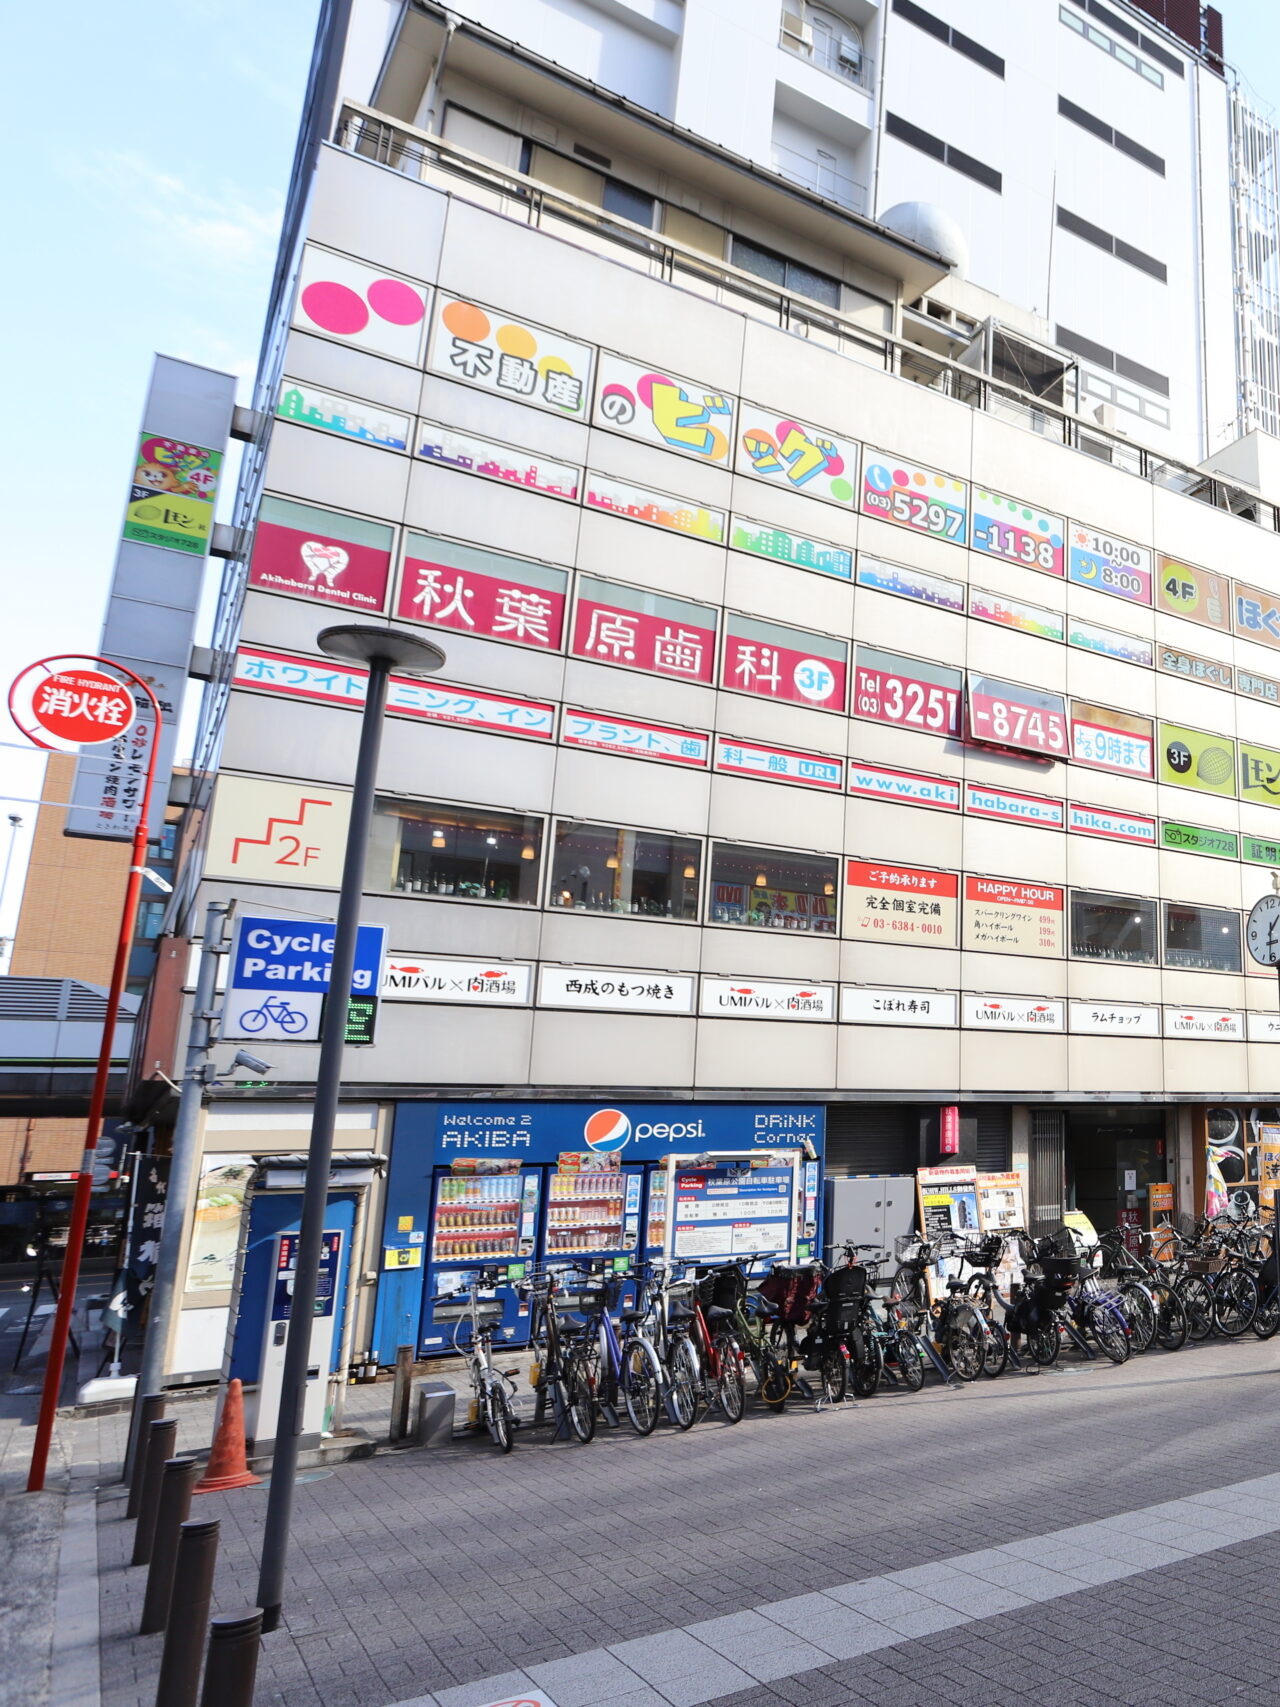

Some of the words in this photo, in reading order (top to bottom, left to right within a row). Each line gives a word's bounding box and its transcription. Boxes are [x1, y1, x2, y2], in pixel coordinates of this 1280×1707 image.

[189, 472, 214, 485] 4F
[133, 488, 150, 499] 3F
[866, 489, 892, 511] (03)
[1092, 536, 1141, 568] 10:00
[260, 572, 315, 592] Akihabara
[317, 584, 351, 600] Dental
[352, 591, 377, 605] Clinic
[1102, 567, 1142, 594] 8:00
[1164, 575, 1196, 601] 4F
[53, 674, 76, 687] FIRE
[77, 678, 122, 693] HYDRANT
[798, 666, 831, 692] 3F
[860, 672, 880, 694] Tel
[38, 685, 128, 727] 消火栓
[858, 697, 881, 716] (03)
[1076, 727, 1149, 769] よる9時まで
[1169, 748, 1190, 766] 3F
[798, 762, 836, 781] URL
[275, 834, 321, 867] 2F
[1182, 832, 1235, 854] スタジオ728
[867, 869, 938, 889] ご予約承ります
[977, 881, 1018, 897] HAPPY
[1021, 887, 1055, 902] HOUR
[864, 896, 942, 917] 完全個室完備
[1265, 899, 1276, 910] 12
[974, 909, 1033, 922] スパークリングワイン
[872, 918, 943, 936] 03-6384-0010
[1251, 931, 1258, 941] 9
[246, 928, 335, 956] Cycle
[1270, 952, 1277, 963] 6
[242, 957, 373, 990] Parkig
[565, 978, 675, 1000] 西成のもつ焼き
[871, 997, 931, 1015] こぼれ寿司
[1090, 1010, 1142, 1027] ラムチョップ
[443, 1114, 516, 1127] Welcome
[520, 1114, 533, 1126] 2
[441, 1130, 532, 1149] AKIBA
[754, 1131, 816, 1144] Corner
